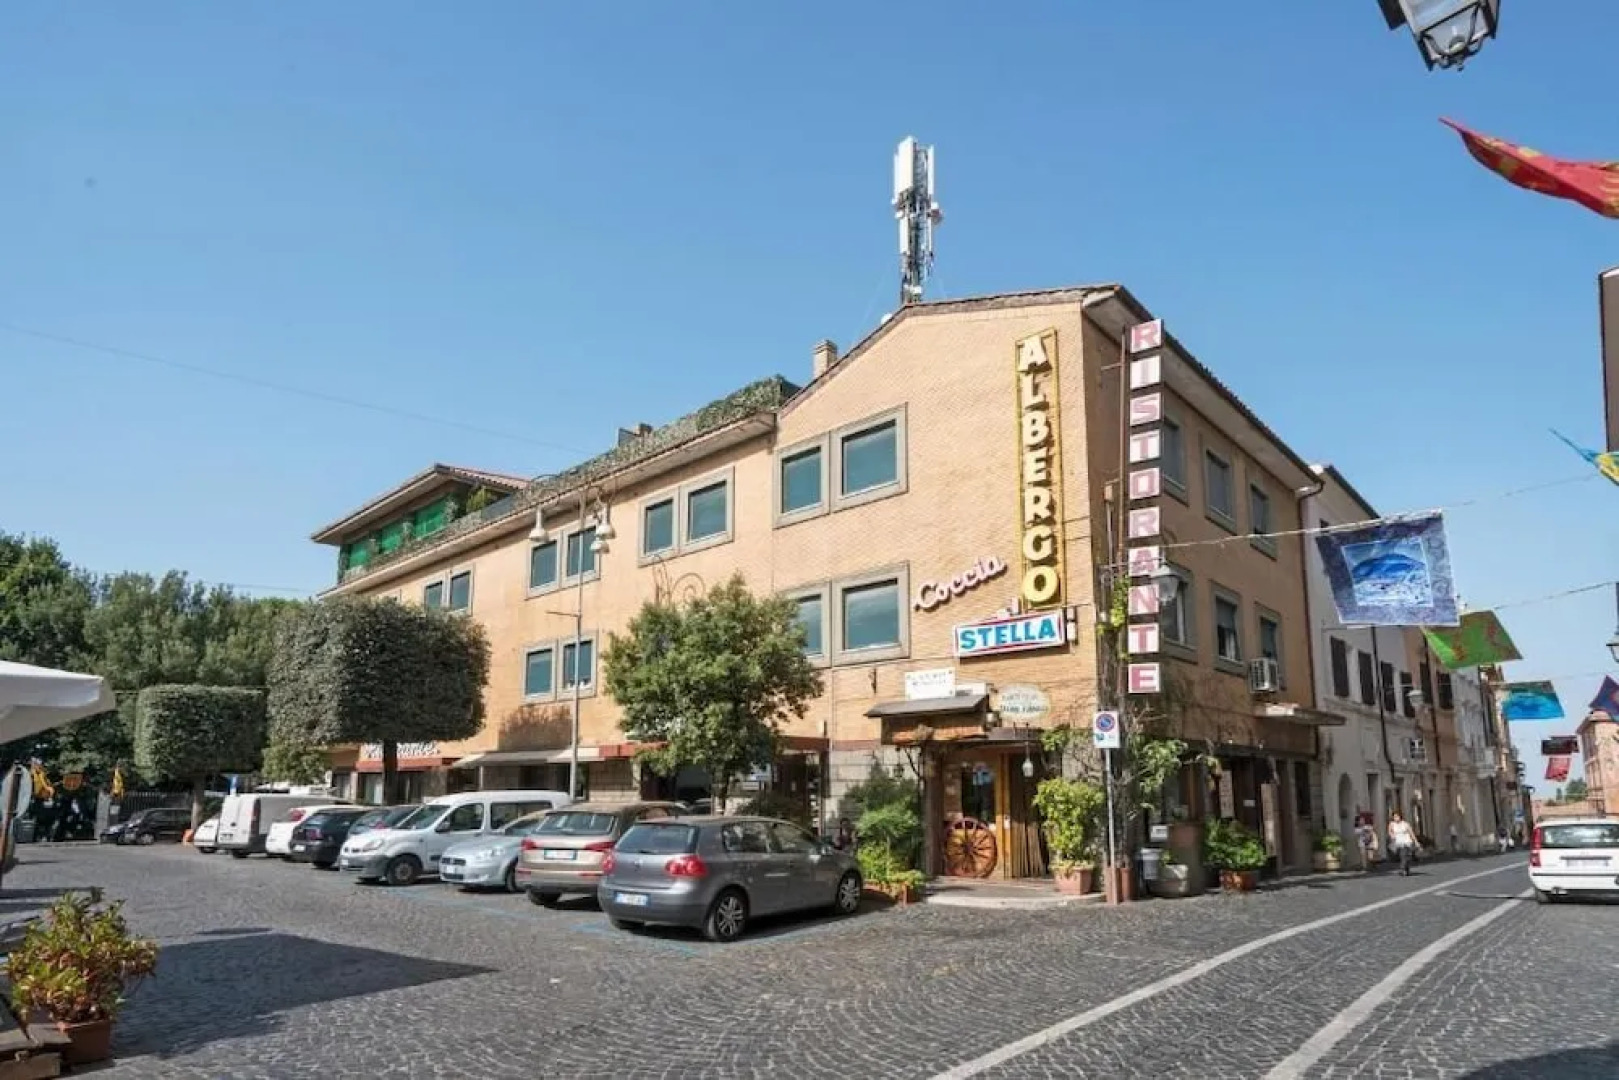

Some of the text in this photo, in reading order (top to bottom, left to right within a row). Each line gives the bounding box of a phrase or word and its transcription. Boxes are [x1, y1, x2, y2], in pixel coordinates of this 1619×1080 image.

[1017, 335, 1058, 603] ALBERGO
[1129, 320, 1161, 692] RISTORANTE
[914, 556, 1006, 609] Coccia
[959, 617, 1055, 650] STELLA
